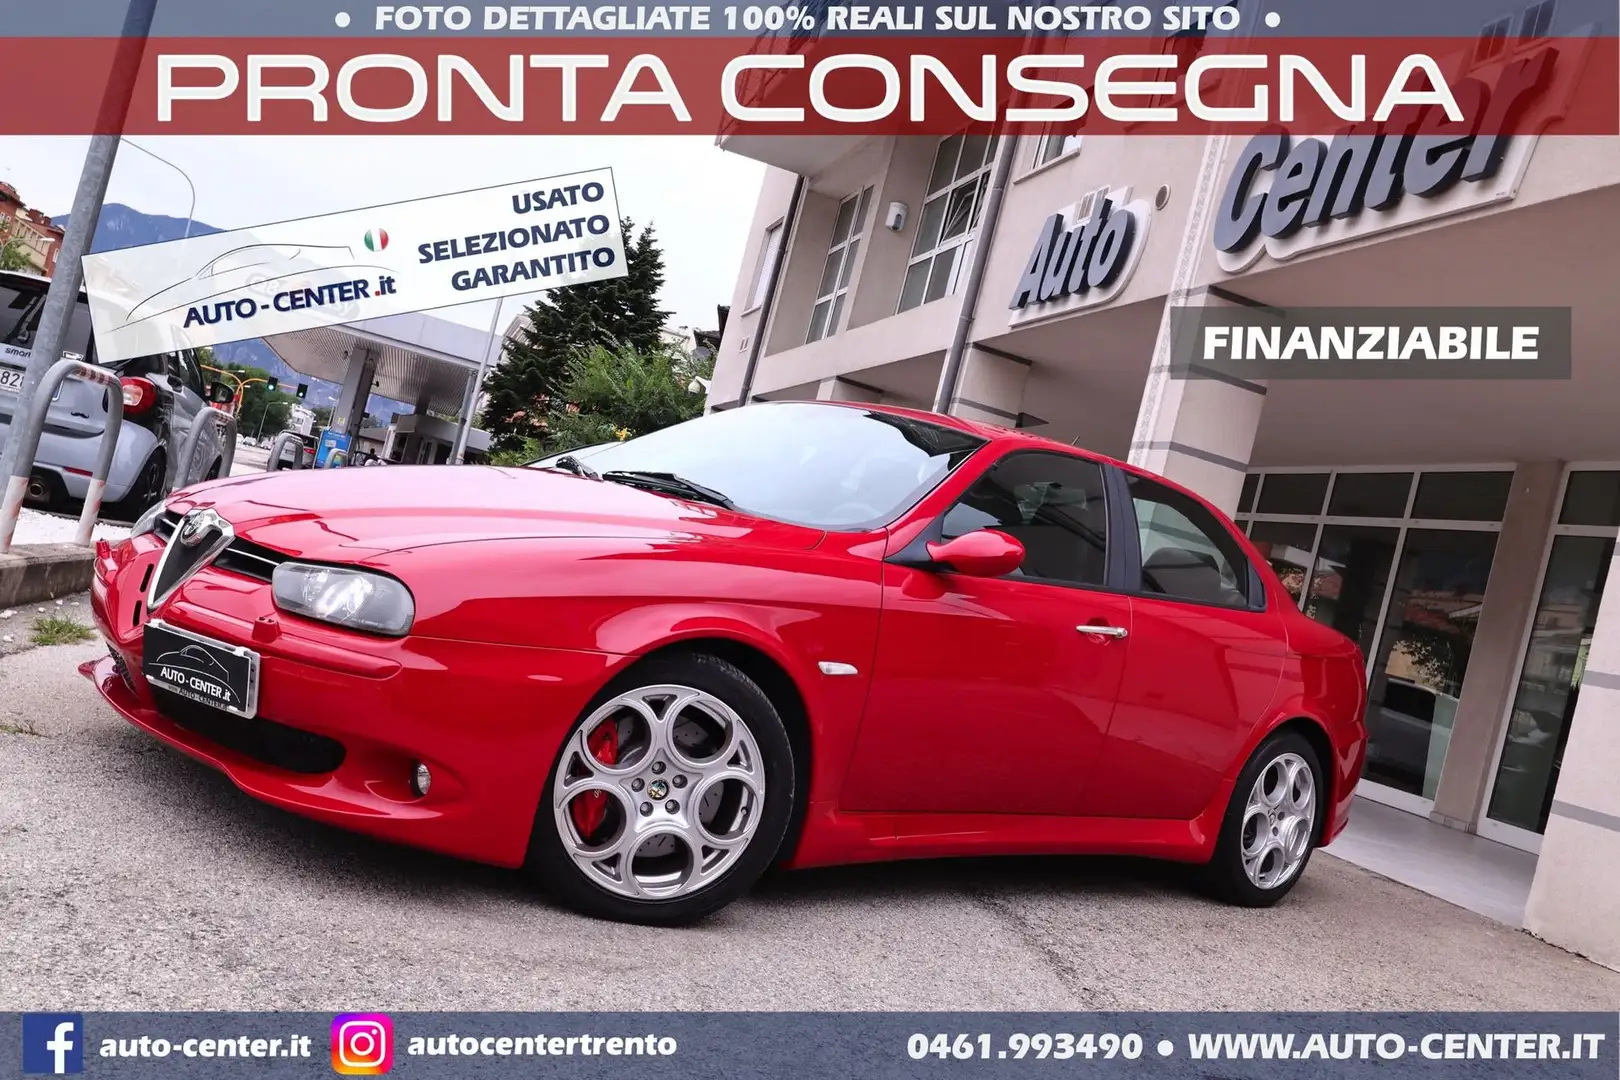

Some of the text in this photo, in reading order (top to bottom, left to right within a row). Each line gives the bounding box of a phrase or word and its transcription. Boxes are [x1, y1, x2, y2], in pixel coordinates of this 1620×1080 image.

[1213, 46, 1560, 253] Center
[1008, 198, 1136, 310] Auto
[0, 371, 25, 387] 82
